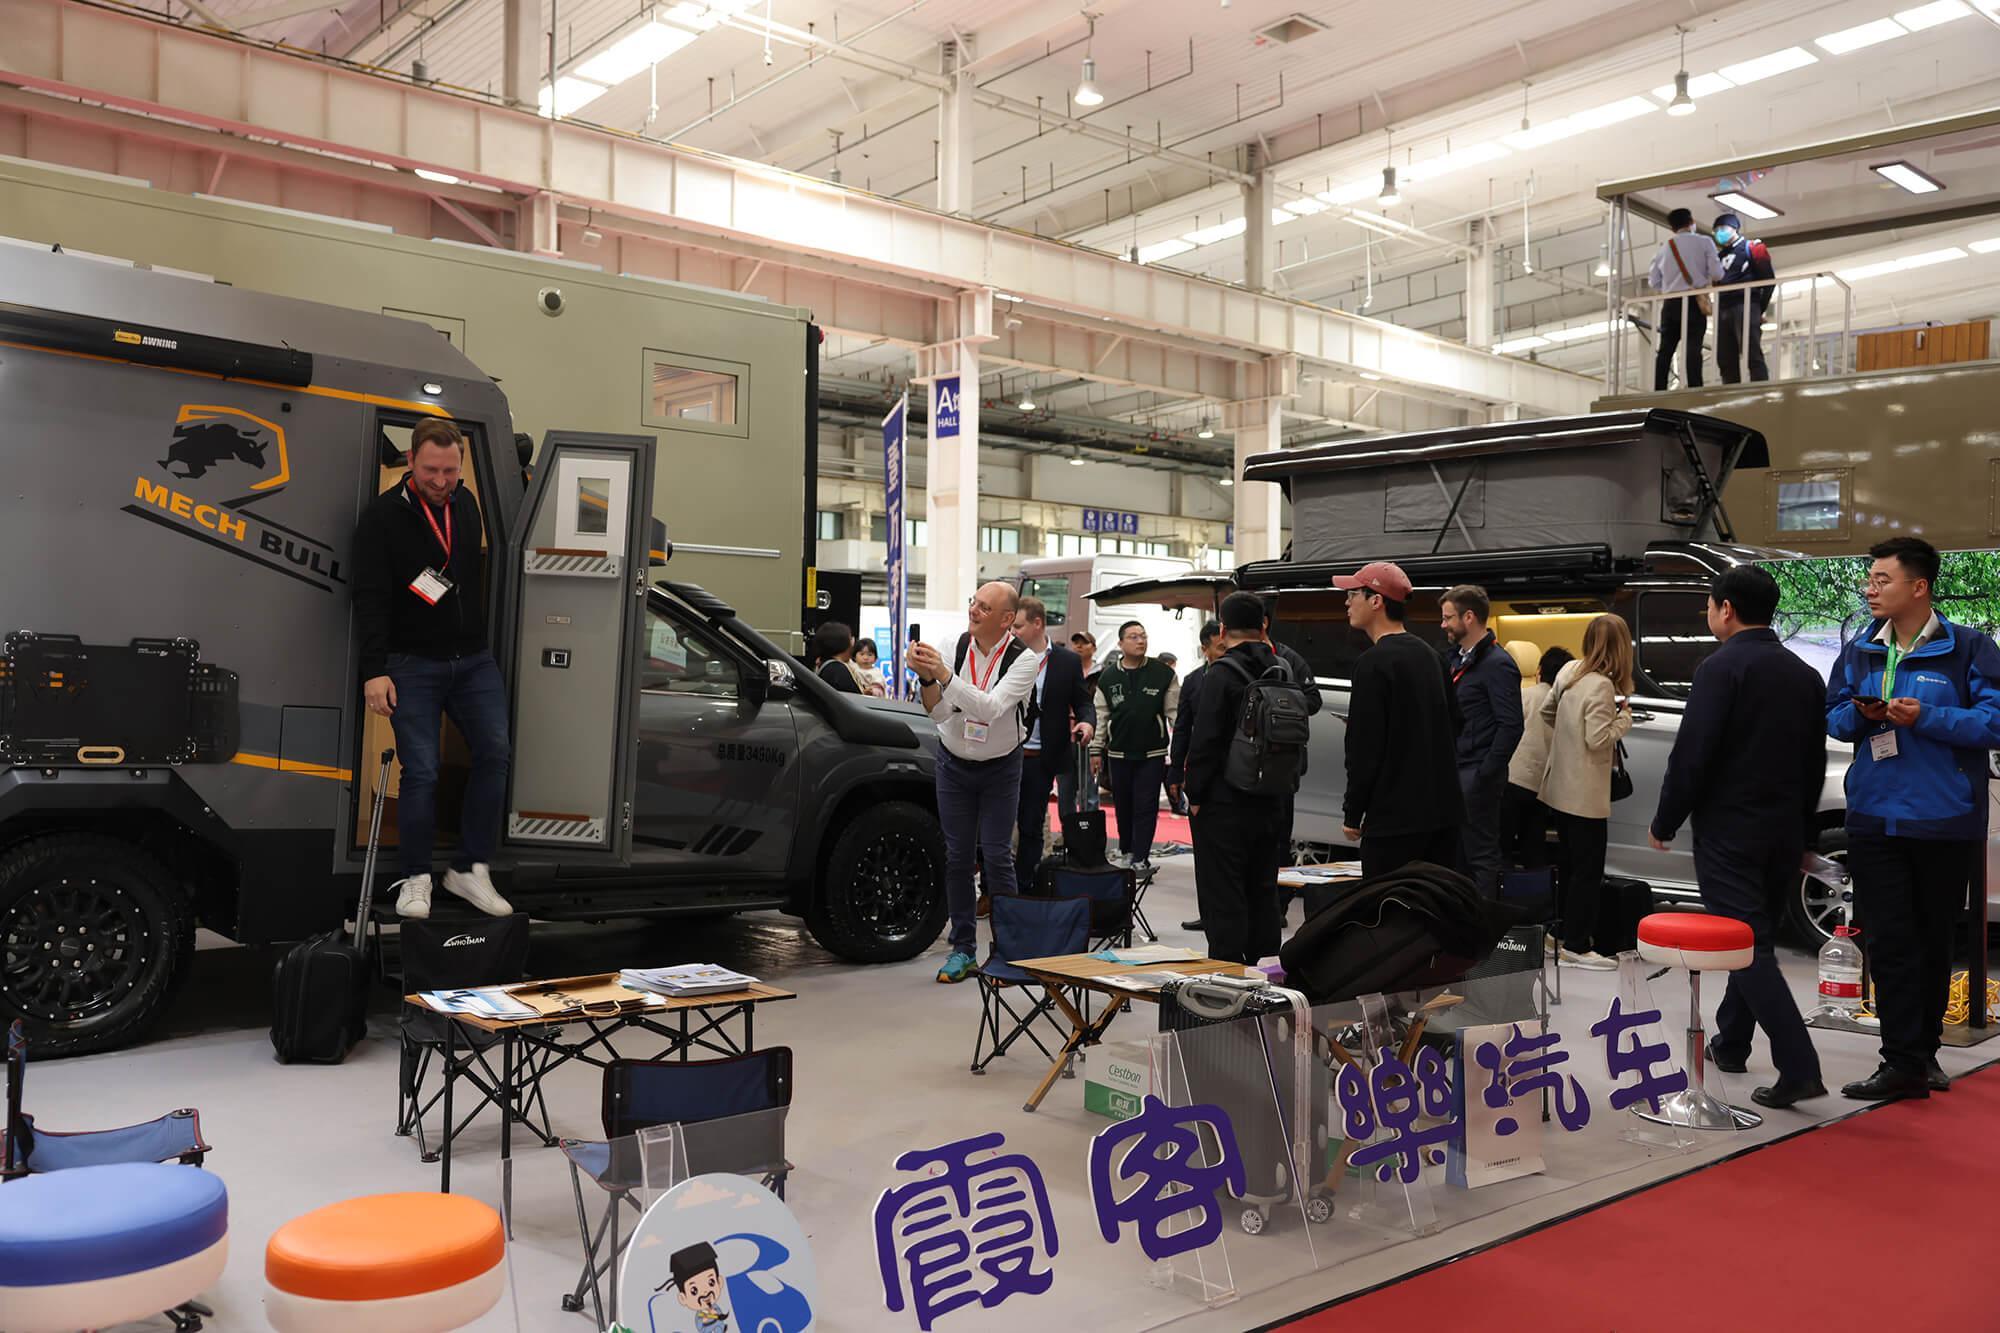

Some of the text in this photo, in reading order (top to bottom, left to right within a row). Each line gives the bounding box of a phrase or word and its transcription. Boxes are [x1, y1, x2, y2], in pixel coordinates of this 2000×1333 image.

[142, 335, 177, 349] AWNING
[937, 416, 958, 428] HALL
[134, 476, 348, 584] MECH BULL
[1108, 1064, 1141, 1083] Cestbon
